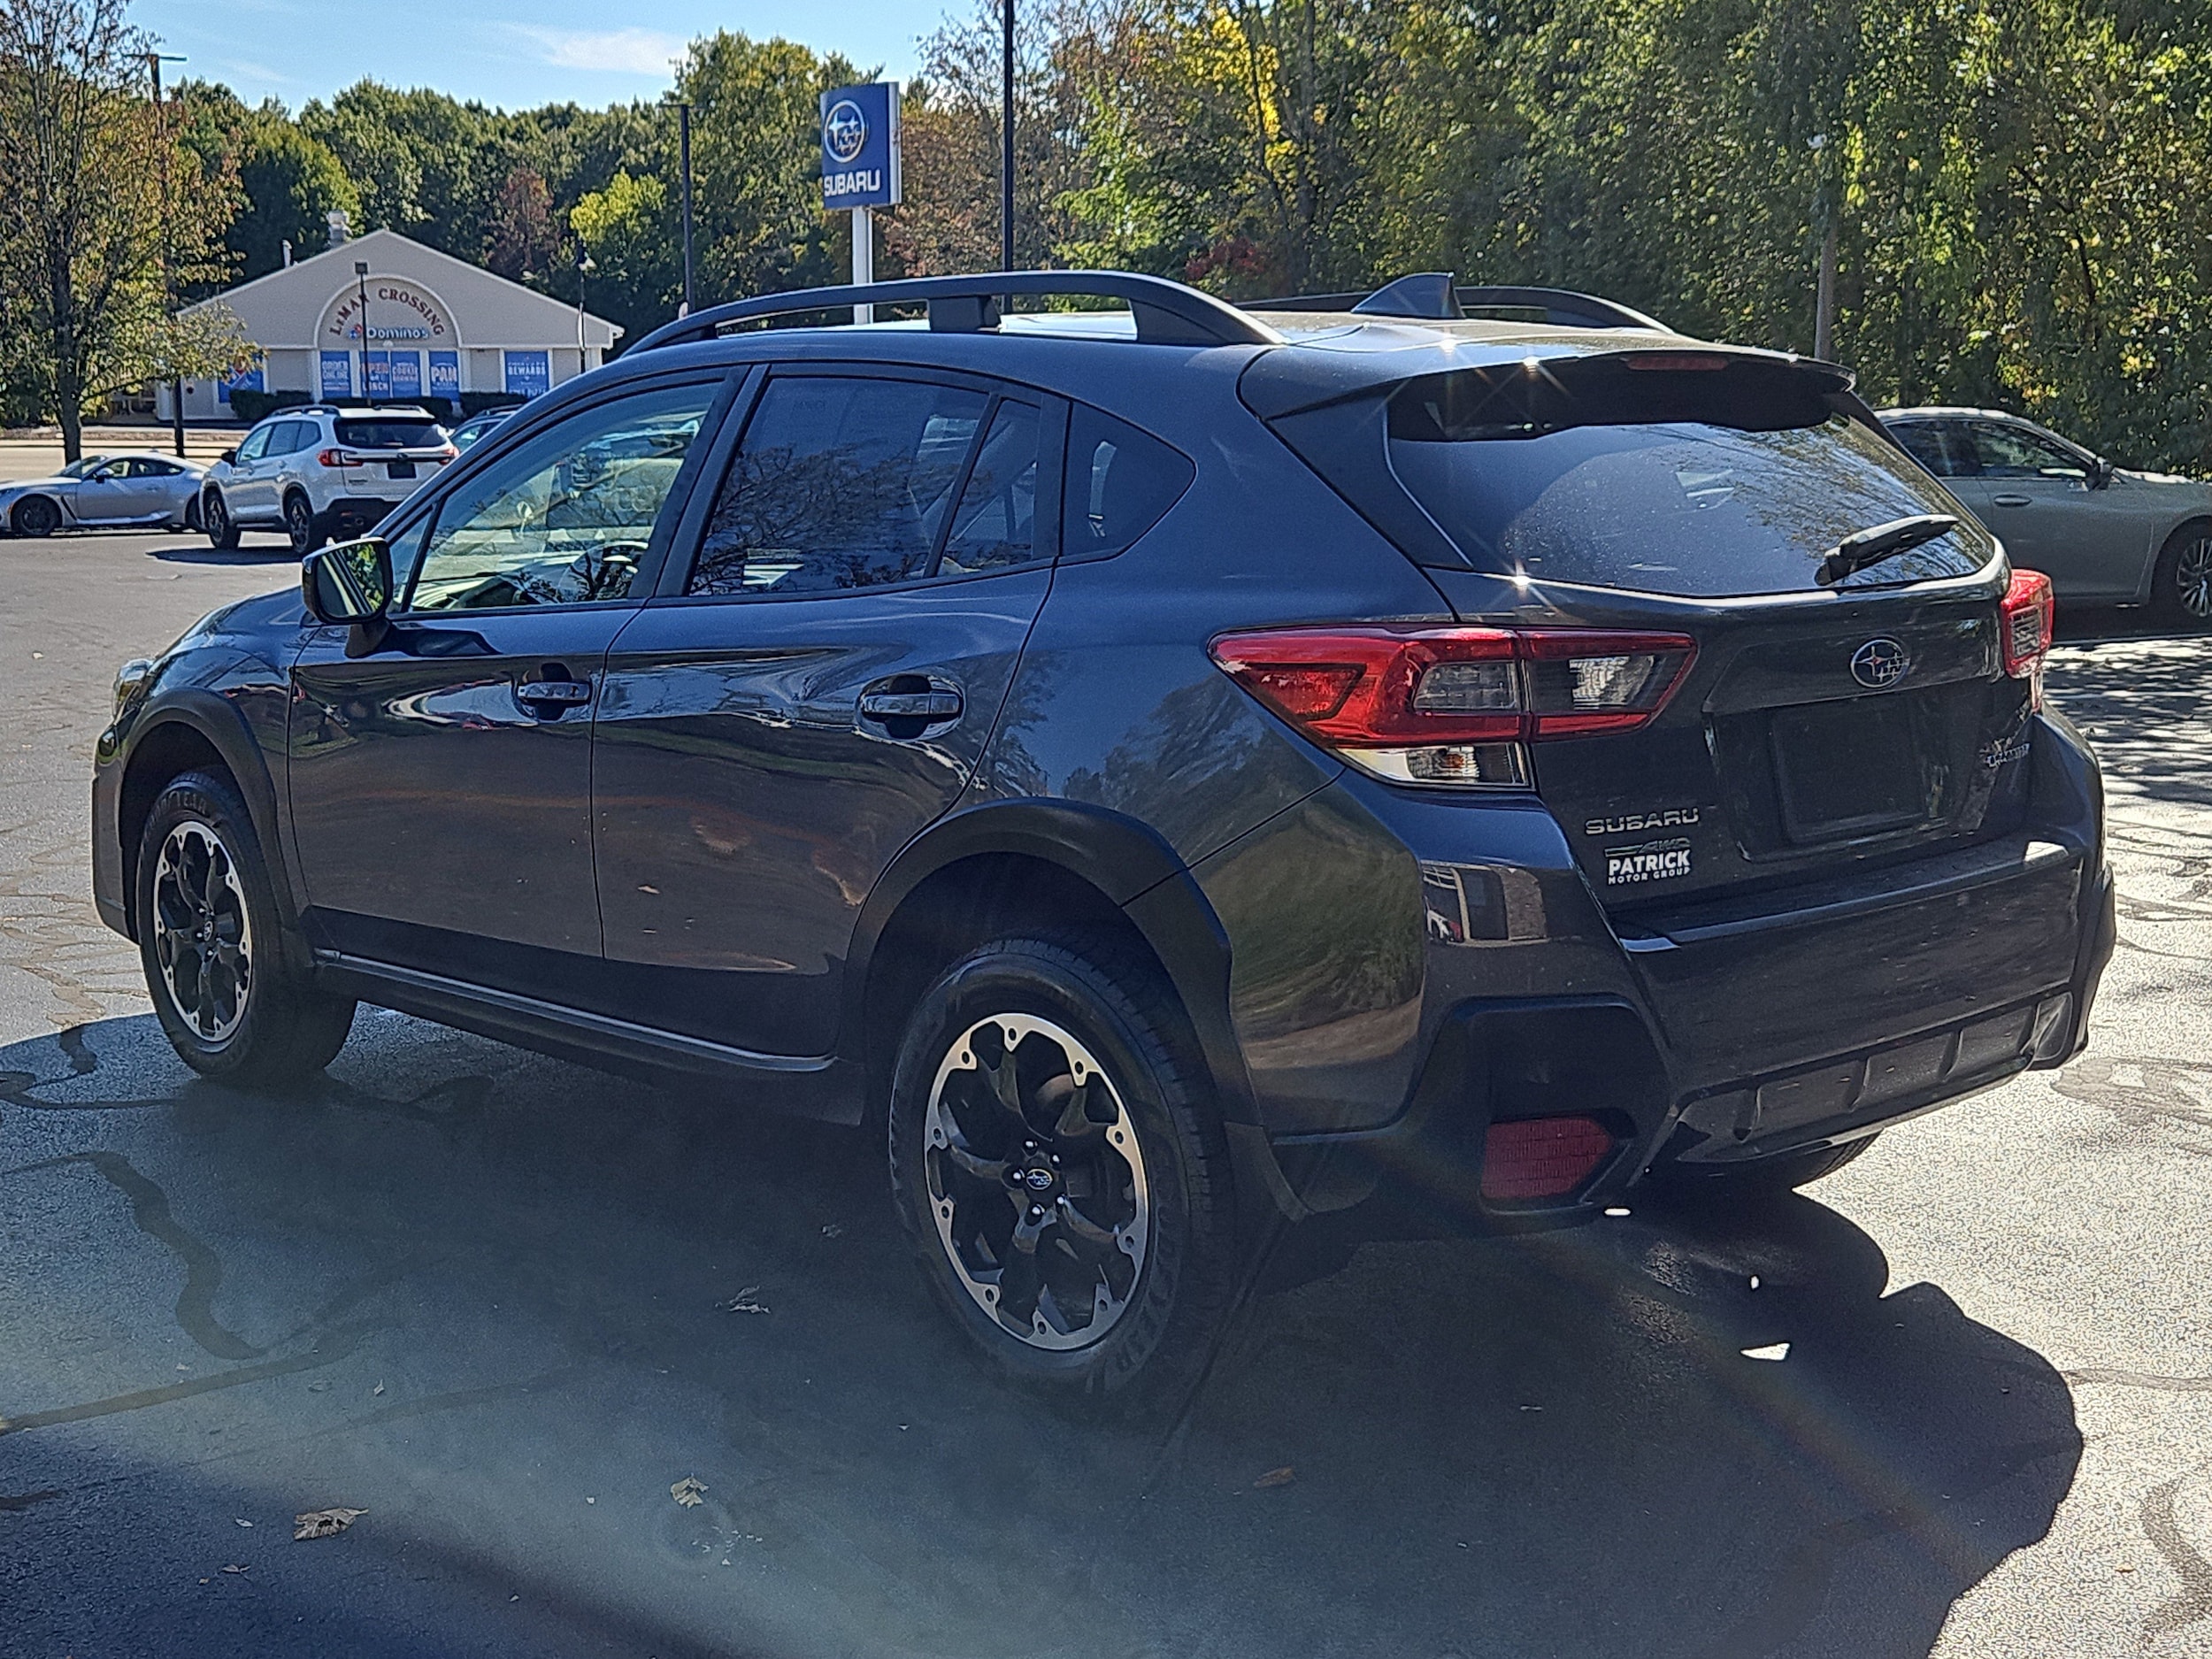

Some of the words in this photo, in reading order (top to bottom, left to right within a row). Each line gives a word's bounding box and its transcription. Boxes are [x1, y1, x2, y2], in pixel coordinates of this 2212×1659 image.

[824, 169, 881, 196] SUBARU
[378, 288, 444, 335] CROSSING
[366, 326, 429, 339] Domino's
[431, 366, 457, 382] PAN
[1585, 808, 1699, 834] SUBARU
[1608, 872, 1648, 885] MOTOR
[1653, 866, 1691, 879] GROUP
[1609, 849, 1691, 876] PATRICK
